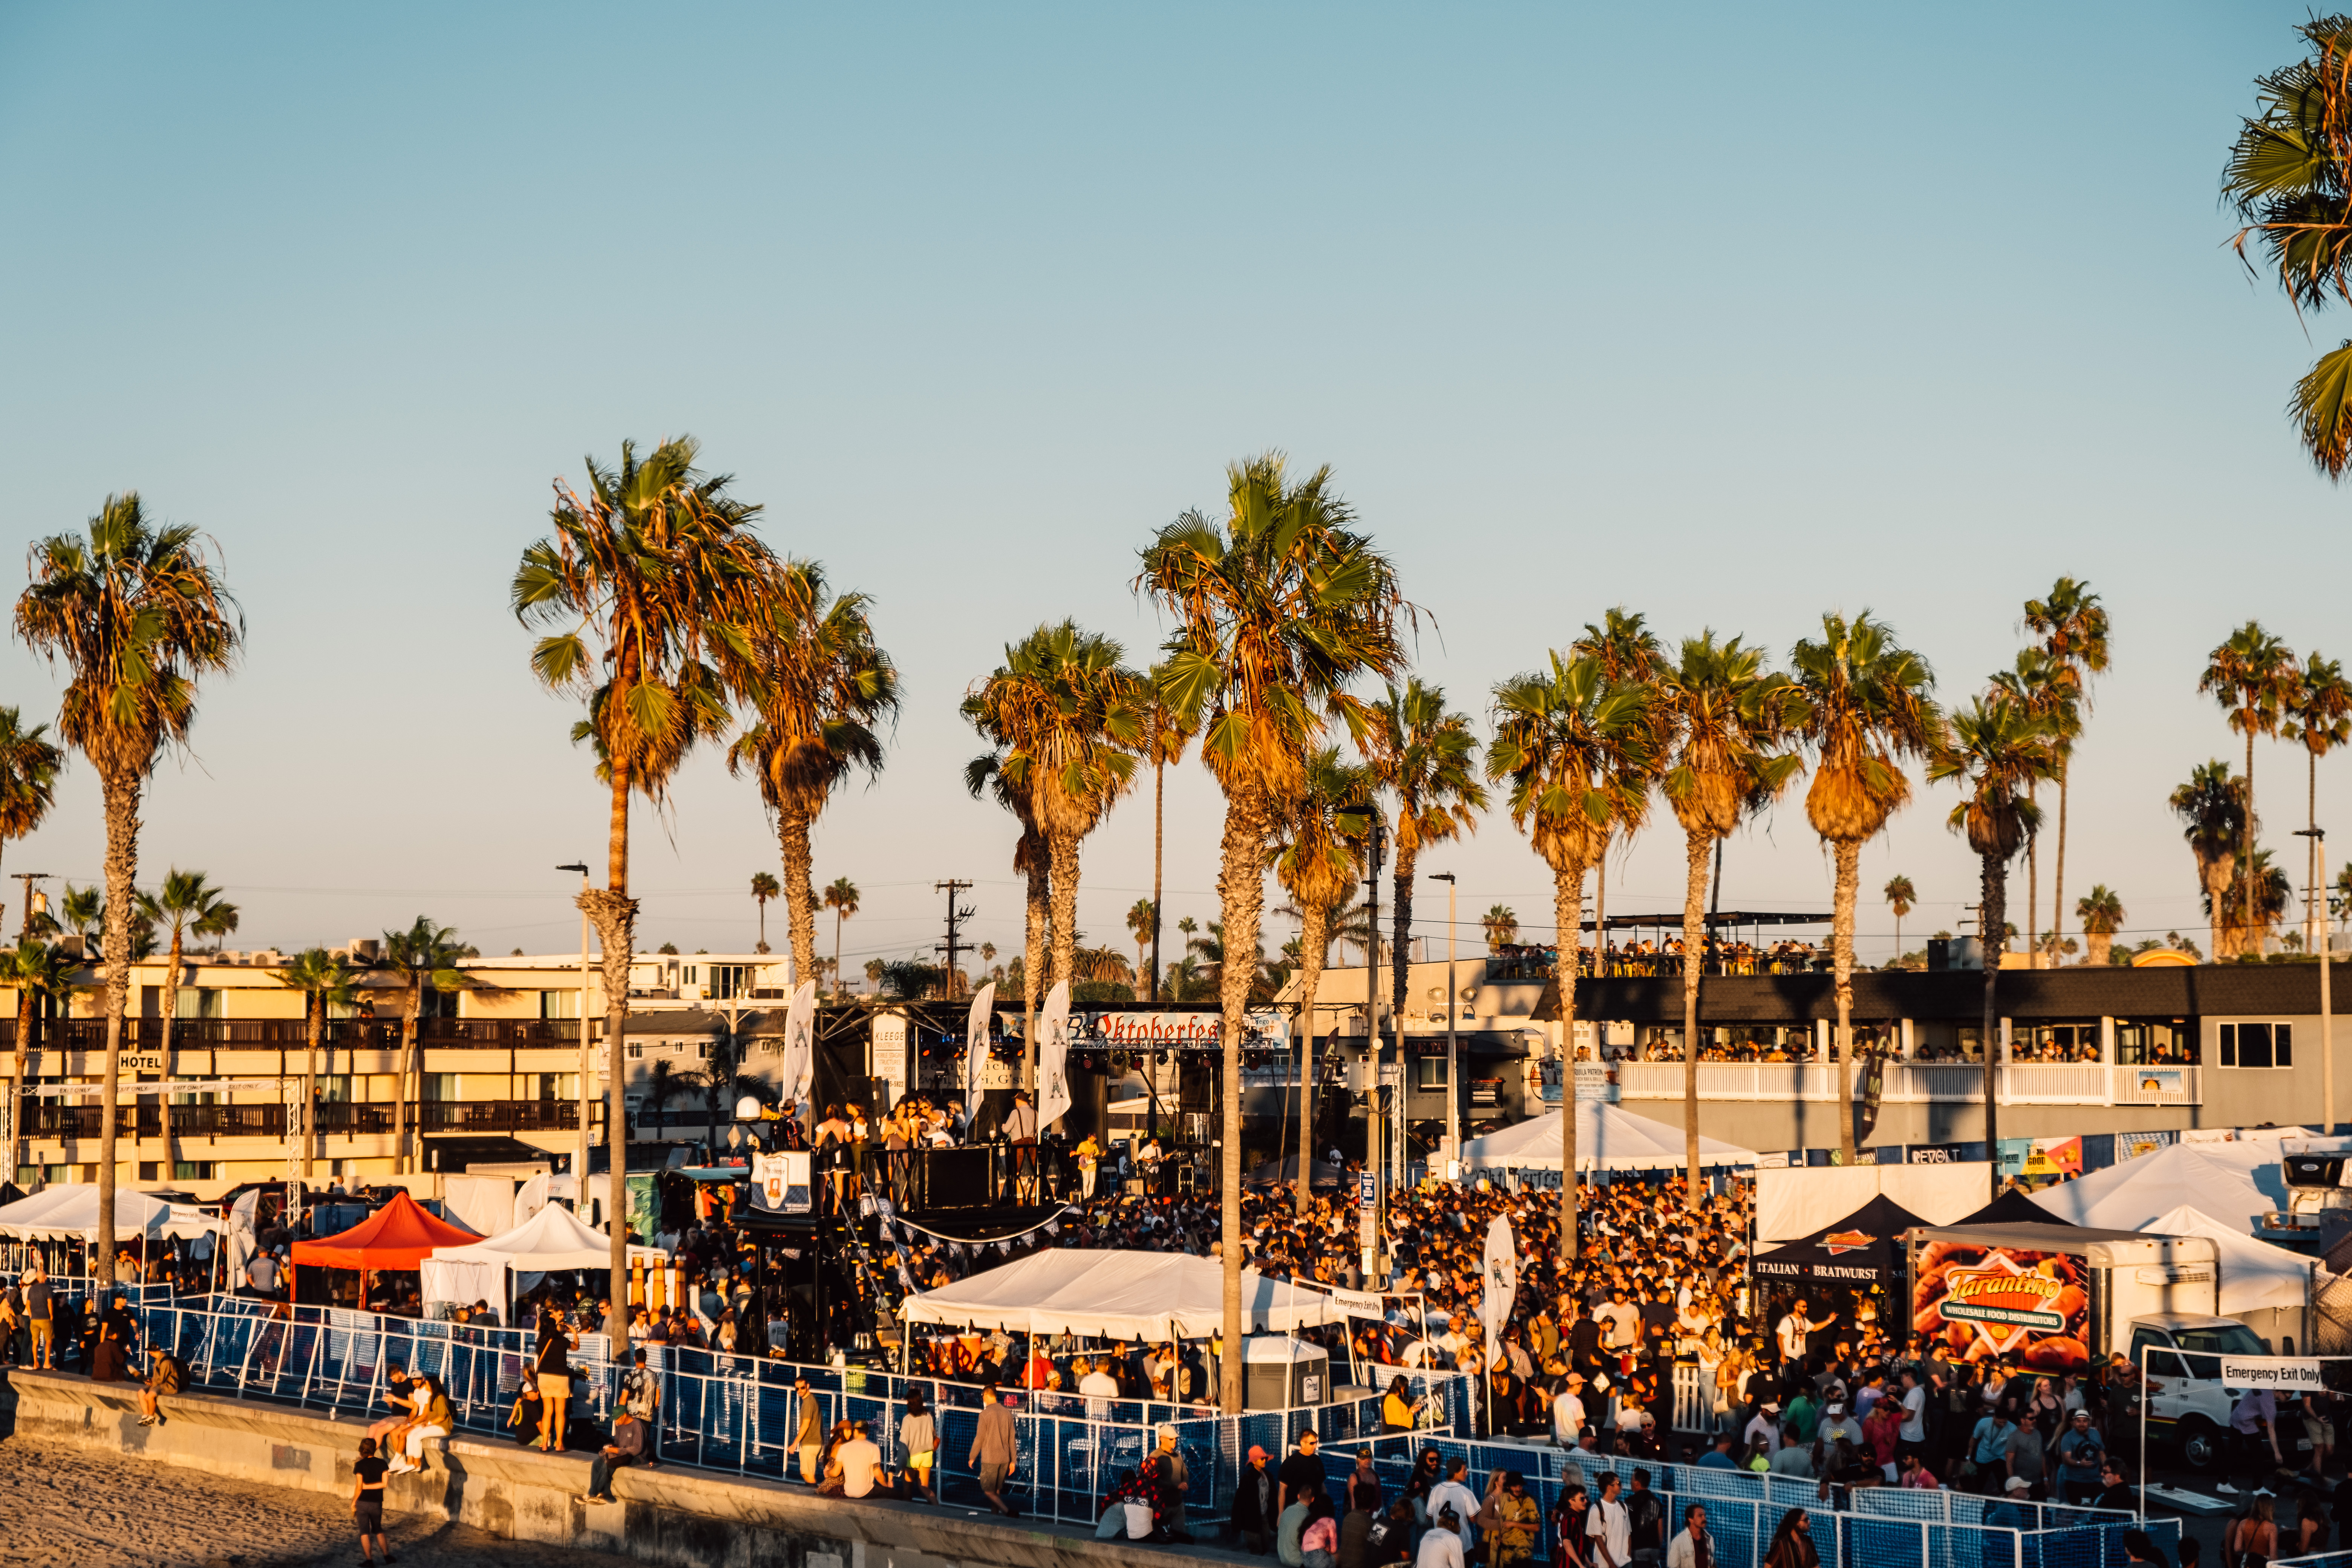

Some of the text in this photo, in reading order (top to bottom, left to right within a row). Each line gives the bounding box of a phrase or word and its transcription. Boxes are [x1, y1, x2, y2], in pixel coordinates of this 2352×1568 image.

[875, 1032, 904, 1040] KLEEGE
[1430, 1042, 1468, 1052] TATOO
[121, 1057, 161, 1068] HOTEL
[1912, 1149, 1960, 1164] REVOLT
[2028, 1157, 2045, 1166] GOOD
[1756, 1262, 1878, 1279] ITALIAN BRATWURST
[1948, 1269, 2060, 1302] Tarantino
[1335, 1297, 1363, 1311] Emergency
[1945, 1306, 2059, 1326] WHOLESALE FOOD DISTRIBUTORS
[2226, 1365, 2320, 1384] Emergency Exit Only
